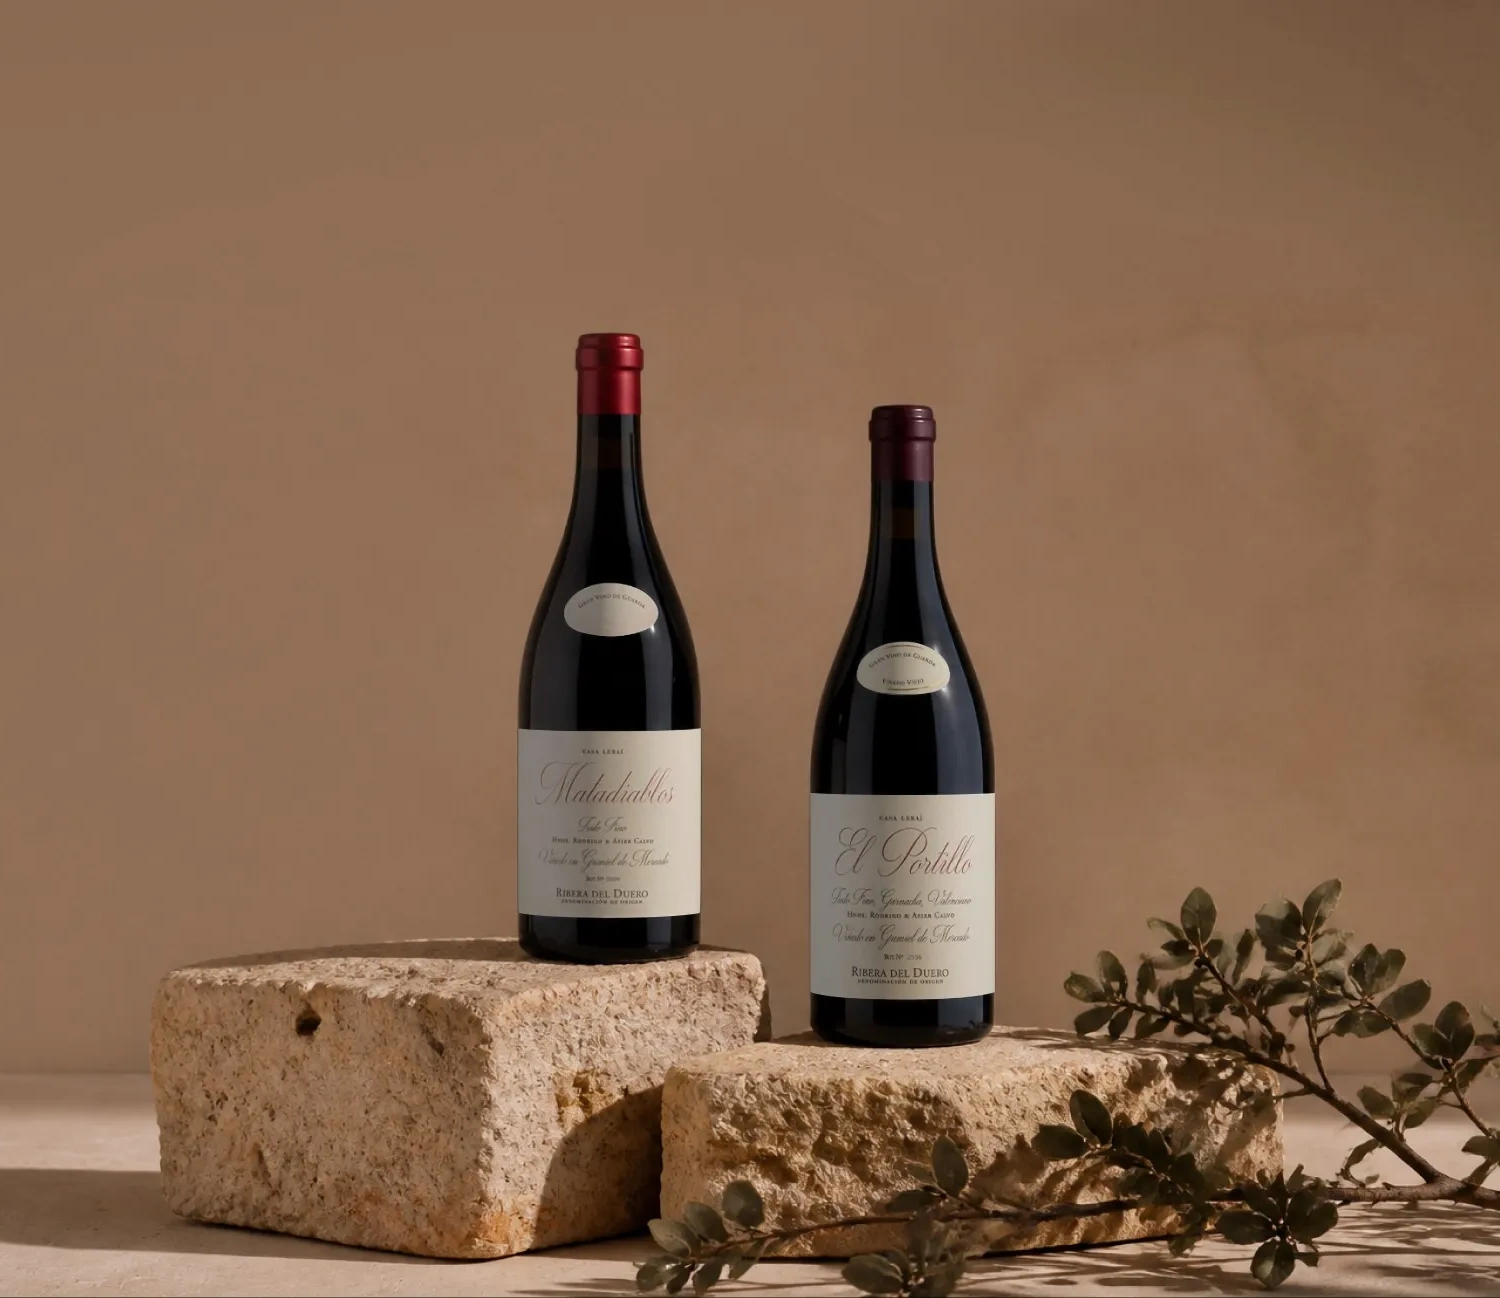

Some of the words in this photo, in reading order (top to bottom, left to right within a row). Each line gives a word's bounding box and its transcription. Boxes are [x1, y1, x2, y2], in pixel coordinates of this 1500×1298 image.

[622, 594, 645, 609] GUARDA
[913, 653, 936, 667] GUARDA
[535, 761, 674, 805] Matadiablos
[835, 827, 877, 876] El
[877, 827, 975, 877] Portillo
[556, 887, 589, 898] RIBERA
[591, 890, 610, 898] DEL
[613, 888, 649, 898] DUERO
[934, 911, 955, 919] CALVO
[917, 929, 929, 942] de
[851, 966, 887, 977] RIBERA
[890, 968, 910, 978] DEL
[913, 967, 949, 978] DUERO
